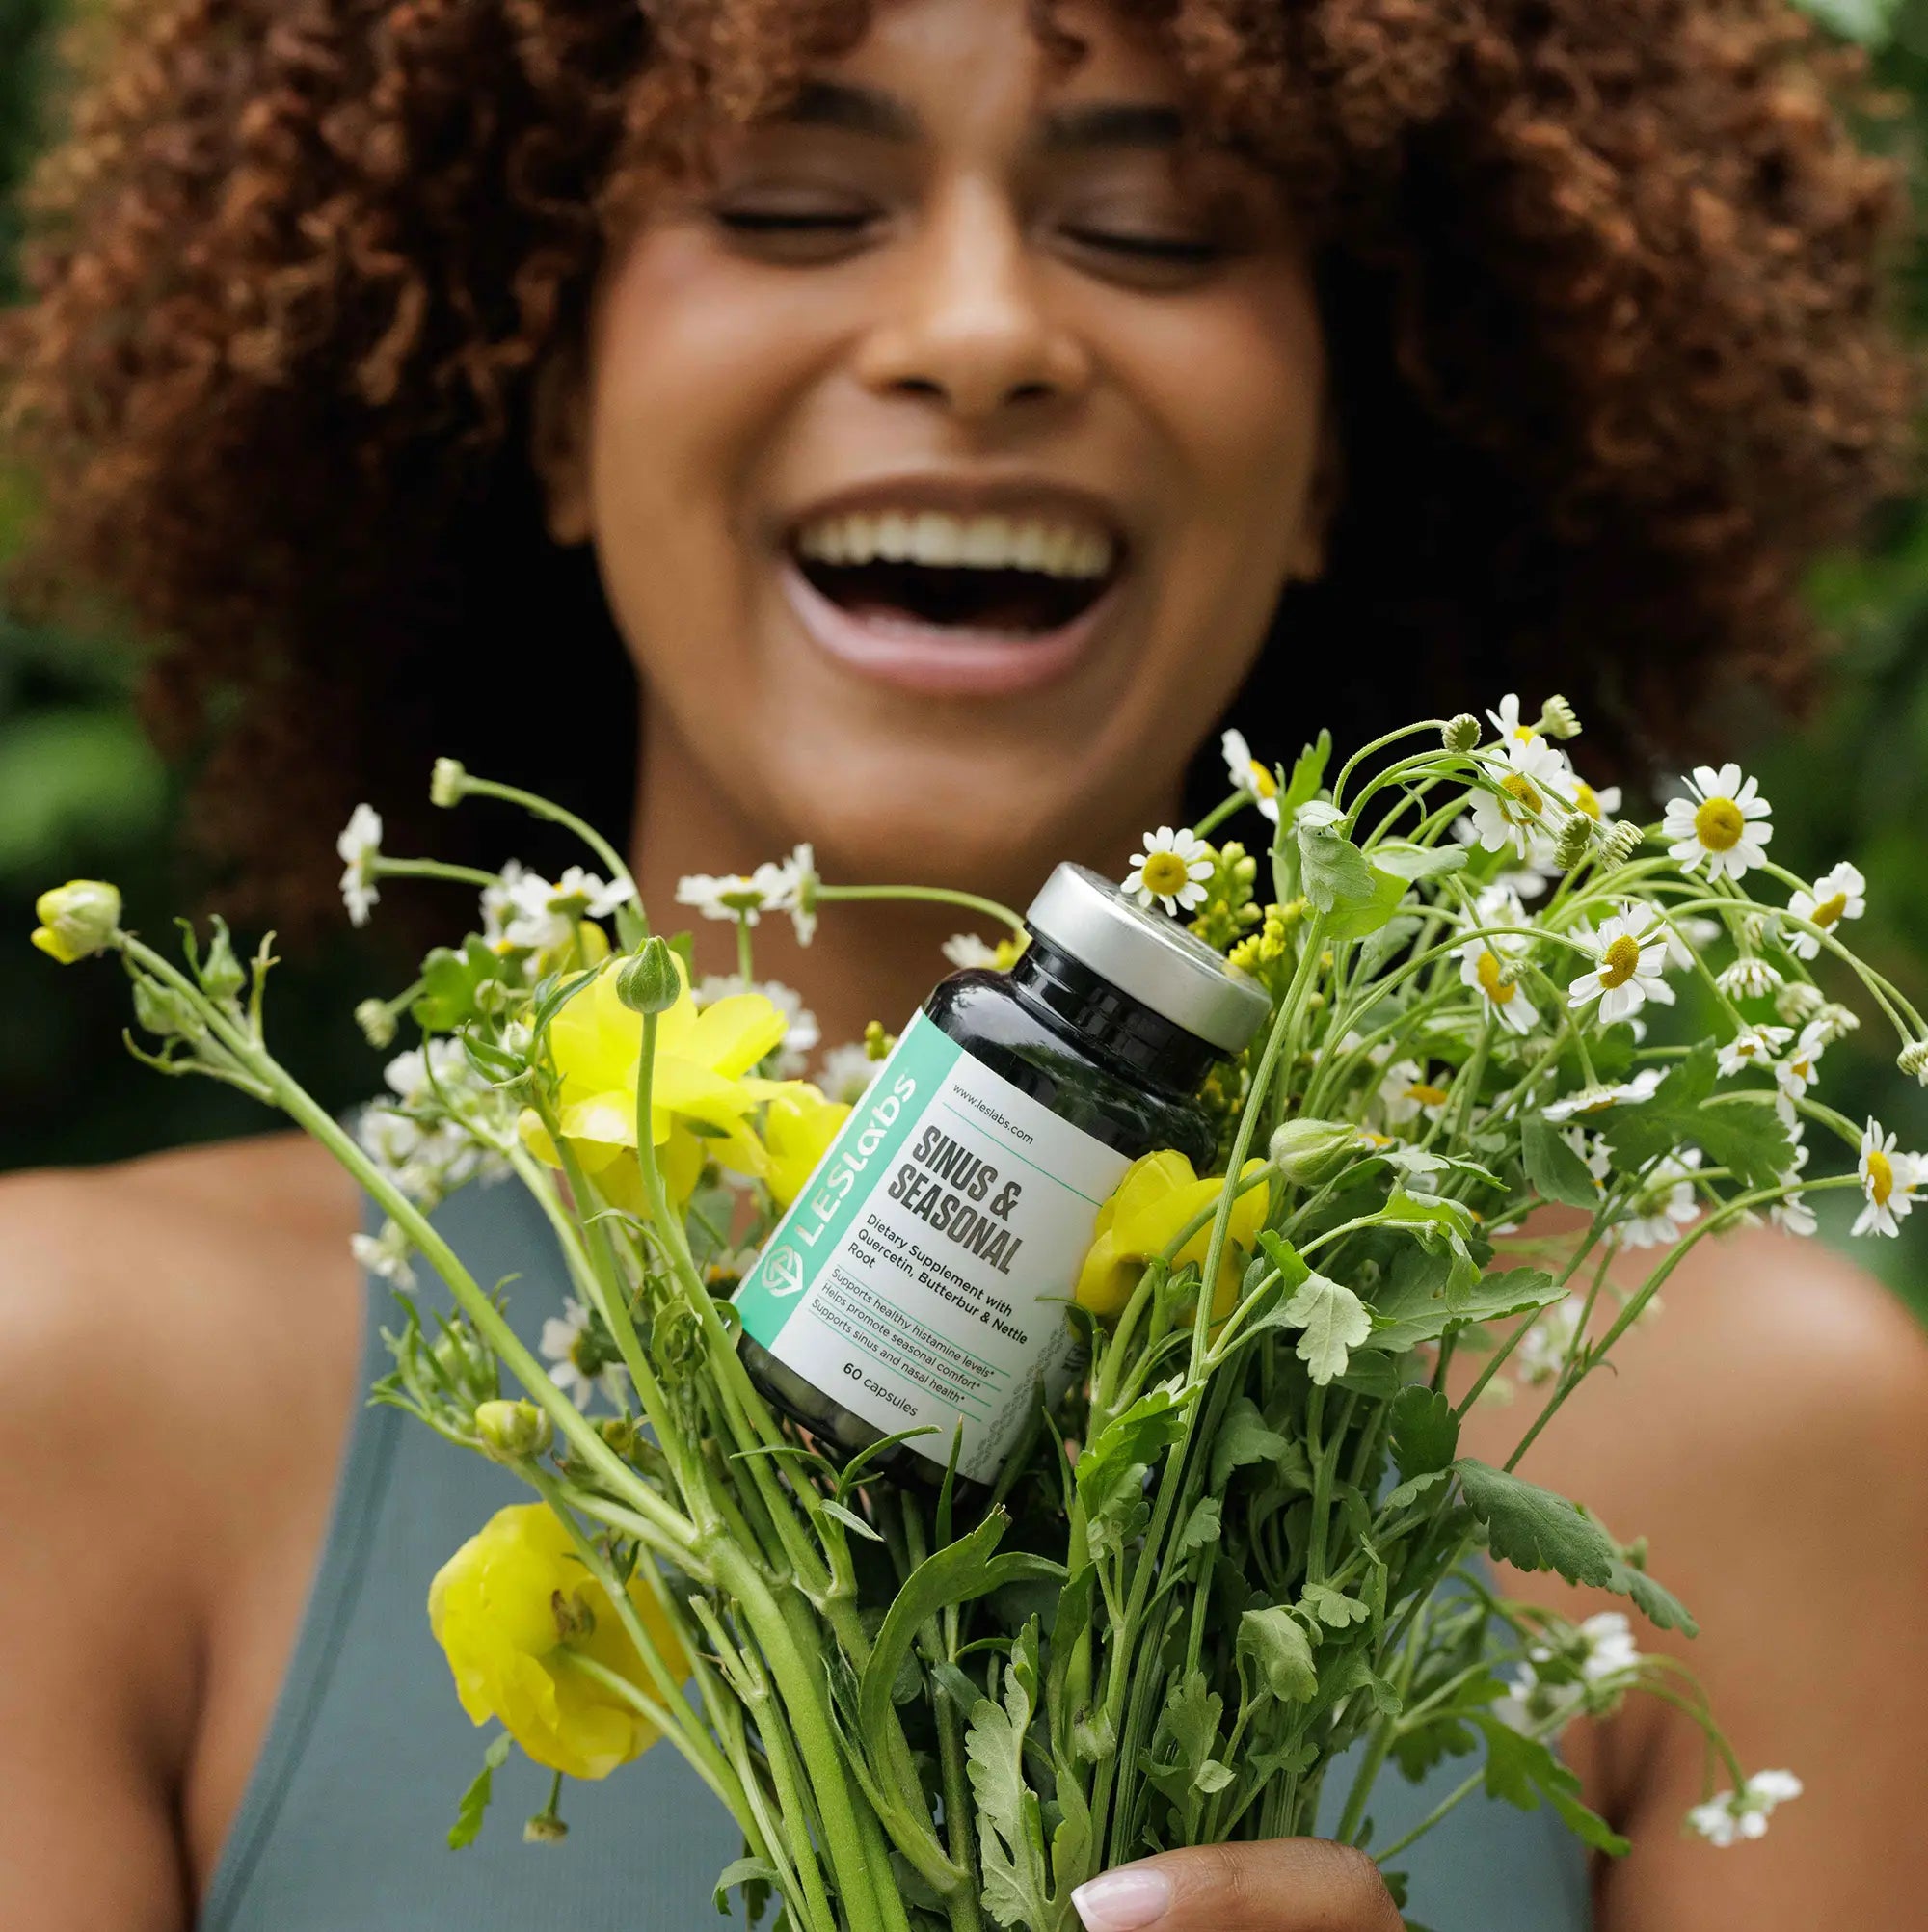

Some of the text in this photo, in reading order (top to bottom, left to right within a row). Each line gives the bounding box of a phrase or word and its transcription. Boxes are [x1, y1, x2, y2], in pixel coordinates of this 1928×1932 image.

[952, 1083, 1034, 1144] www.leslabs.com
[912, 1125, 1022, 1221] SINUS &
[847, 1242, 876, 1269] Root
[887, 1164, 1023, 1275] SEASONAL
[858, 1228, 1028, 1345] Quercetin, Butterbur & Nettle
[867, 1214, 1013, 1317] Dietary Supplement with
[811, 1298, 852, 1334] Supports
[852, 1328, 879, 1353] sinus
[879, 1348, 900, 1367] and
[900, 1363, 928, 1384] nasal
[821, 1283, 846, 1307] Helps
[846, 1299, 890, 1338] promote
[891, 1333, 935, 1367] seasonal
[831, 1269, 872, 1303] Supports
[873, 1297, 912, 1330] healthy
[912, 1325, 962, 1361] histamine
[843, 1362, 919, 1417] 60 capsules
